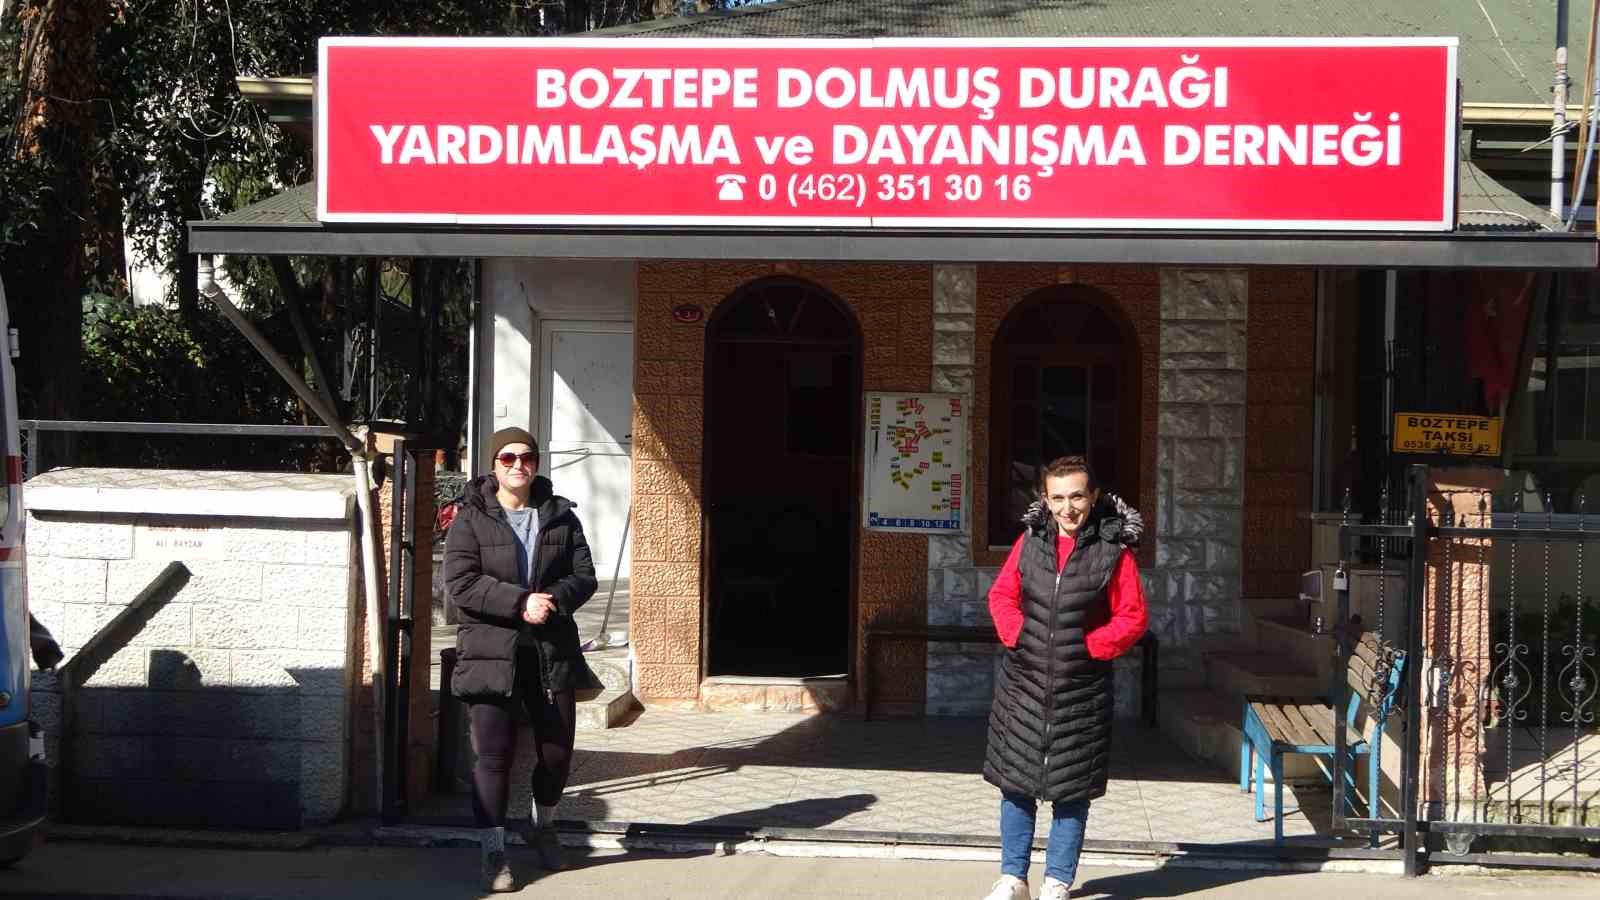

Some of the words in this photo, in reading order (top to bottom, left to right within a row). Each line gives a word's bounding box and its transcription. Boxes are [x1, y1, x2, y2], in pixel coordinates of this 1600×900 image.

[536, 67, 759, 109] BOZTEPE
[776, 66, 1001, 120] DOLMUŞ
[1020, 53, 1228, 109] DURAĞI
[369, 124, 742, 171] YARDIMLAŞMA
[754, 136, 814, 165] ve
[832, 124, 1148, 178] DAYANIŞMA
[1163, 112, 1401, 167] DERNEĞİ
[758, 174, 777, 201] 0
[787, 173, 867, 207] (462)
[877, 174, 931, 201] 351
[944, 174, 983, 201] 30
[994, 174, 1032, 201] 16
[1408, 417, 1489, 431] BOZTEPE
